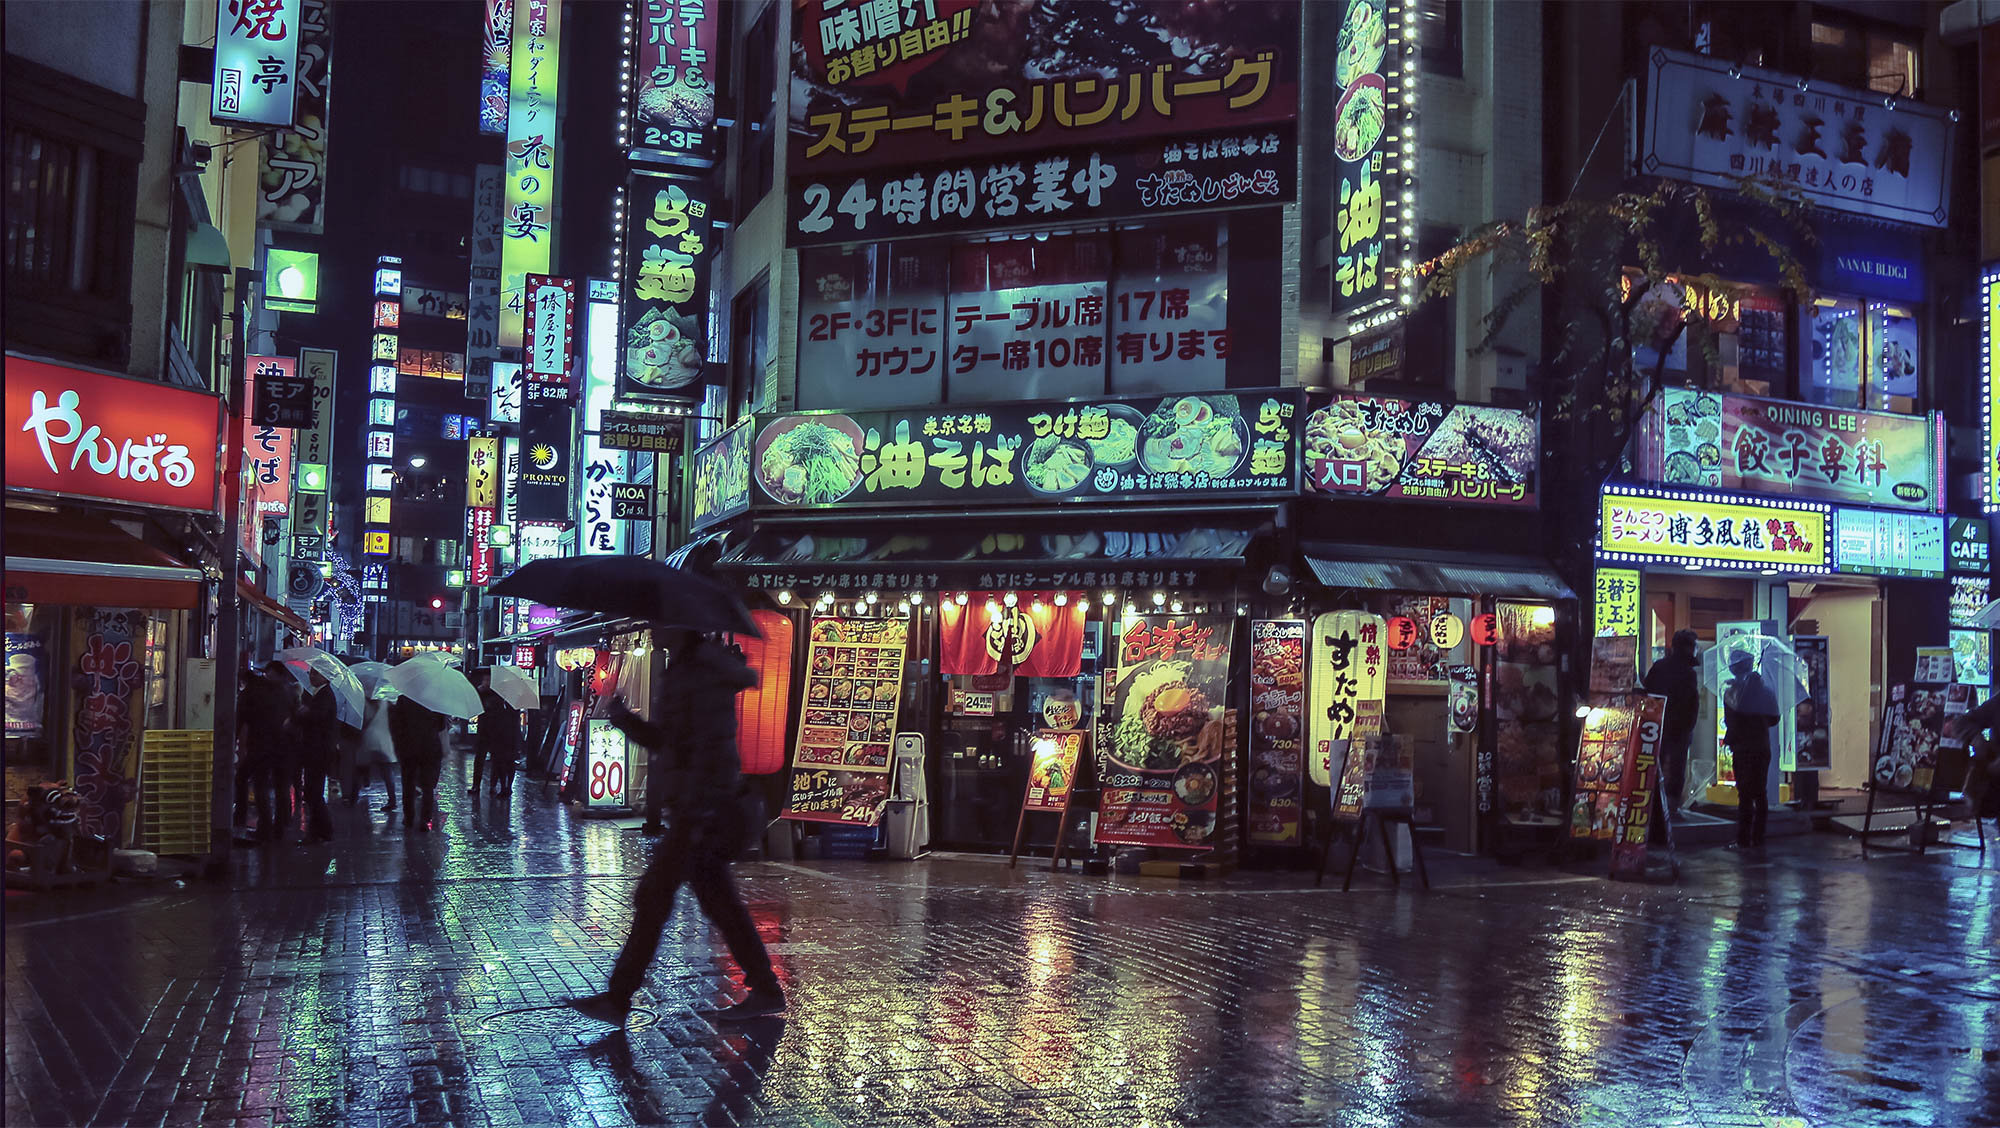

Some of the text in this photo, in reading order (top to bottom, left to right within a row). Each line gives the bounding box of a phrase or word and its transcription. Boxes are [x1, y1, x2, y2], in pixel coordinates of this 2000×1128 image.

[648, 0, 678, 87] ンバーグ
[806, 53, 1275, 158] ステーキ&ハンバーグ
[1163, 133, 1280, 165] 油そば総本店
[504, 134, 552, 243] 花の宴
[799, 153, 1118, 234] 24時間営業中
[1336, 158, 1383, 298] 油そば
[634, 184, 704, 302] らぁ麺
[954, 303, 1104, 336] テーブル席
[1117, 288, 1190, 322] 17席
[541, 291, 562, 370] 椿屋カフェ
[265, 381, 304, 398] モア
[527, 383, 540, 391] 2F
[527, 392, 540, 400] 3F
[542, 386, 568, 400] 82席
[923, 413, 992, 437] 東京名物
[1027, 404, 1112, 439] つけ麺
[1356, 398, 1430, 436] すためし
[1767, 405, 1857, 433] DINING LEE
[22, 389, 195, 488] やんばる
[602, 433, 680, 451] お替り自由!!
[1248, 397, 1291, 476] らぁ麺
[861, 419, 1022, 493] 油そば
[1735, 424, 1889, 488] 餃子専科
[523, 473, 566, 484] PRONTO
[1120, 471, 1209, 491] 油そば総本店
[1320, 462, 1362, 487] 入口
[1417, 458, 1490, 481] ステーキ&
[615, 487, 646, 500] MOA
[1451, 479, 1526, 501] ハンバーグ
[585, 459, 617, 551] かぶら屋
[615, 502, 634, 517] 3rd
[1611, 508, 1665, 524] とんこつ
[298, 536, 320, 546] モア
[1667, 512, 1764, 550] 博多風龍
[1962, 523, 1977, 540] 4F
[1951, 541, 1989, 560] CAFE
[1360, 623, 1381, 678] 情熱の
[966, 697, 980, 709] 24
[793, 770, 837, 791] 地下に
